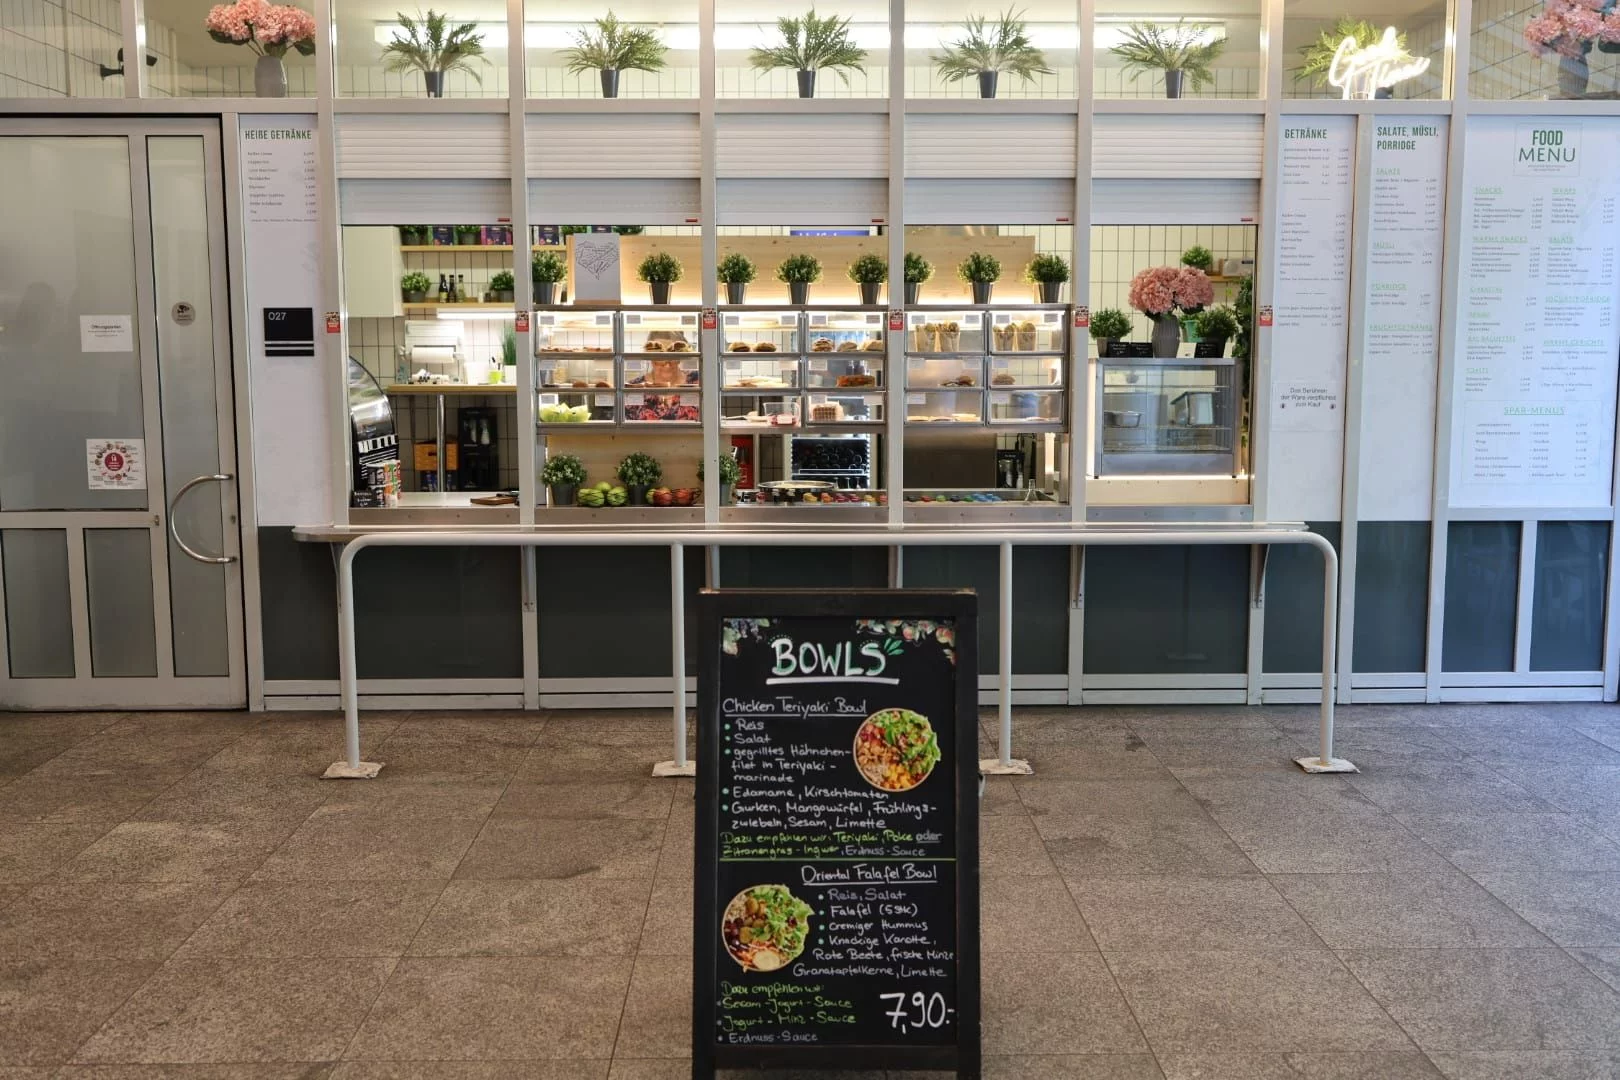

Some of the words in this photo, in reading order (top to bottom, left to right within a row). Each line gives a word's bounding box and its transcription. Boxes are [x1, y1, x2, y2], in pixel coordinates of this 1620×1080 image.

[271, 128, 312, 140] GETRÄNKE
[1284, 128, 1328, 139] GETRÄNKE
[1377, 126, 1409, 137] SALATE,
[1411, 124, 1439, 137] MÜSLI,
[1532, 129, 1563, 146] FOOD
[1376, 140, 1416, 150] PORRIDGE
[1518, 147, 1576, 163] MENU
[771, 637, 887, 677] BOWLS
[722, 697, 775, 713] Chicken
[776, 696, 830, 719] Teriyaki
[834, 697, 866, 714] Bowl
[735, 718, 765, 731] Reis
[734, 733, 772, 745] Salat
[733, 746, 784, 761] gegrilltes
[731, 760, 757, 773] filet
[763, 761, 773, 769] in
[733, 773, 795, 783] marinade
[804, 785, 889, 799] Kirschtomaten
[835, 816, 887, 829] Limette
[915, 828, 943, 842] oder
[801, 865, 850, 883] Oriental
[852, 863, 900, 884] Falafel
[902, 863, 937, 880] Bowl
[865, 888, 907, 901] Salat
[831, 904, 871, 919] Falafel
[881, 919, 928, 931] Hummus
[812, 948, 844, 960] Rote
[890, 948, 922, 961] frische
[901, 964, 947, 977] Limette
